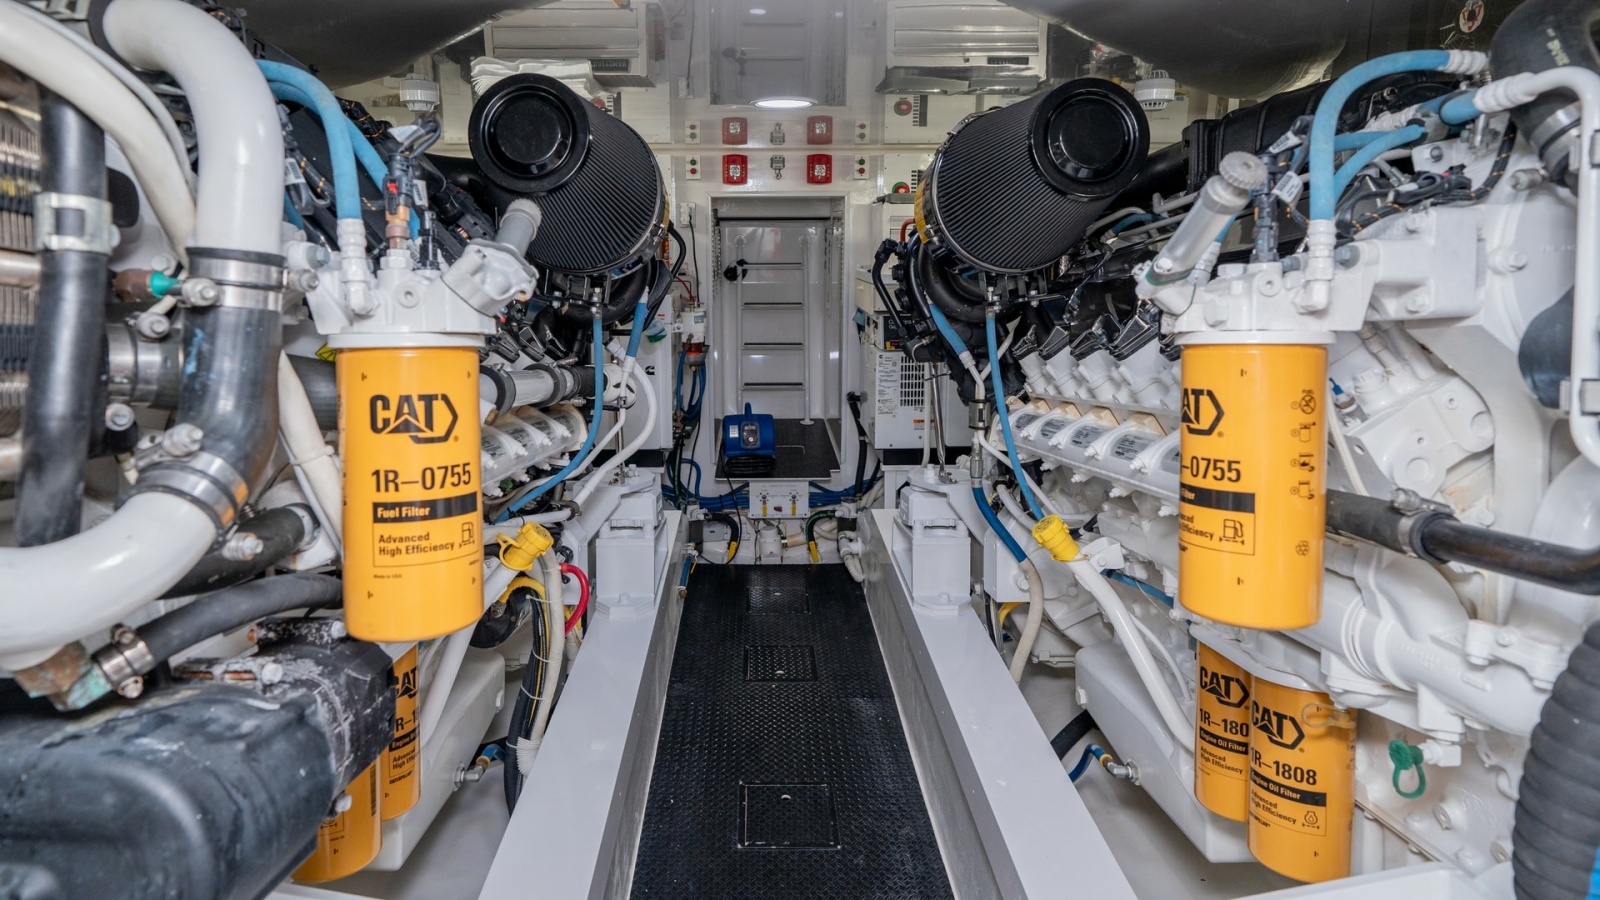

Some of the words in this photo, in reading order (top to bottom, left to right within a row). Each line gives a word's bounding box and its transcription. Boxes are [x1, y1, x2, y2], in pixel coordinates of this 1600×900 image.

[370, 394, 439, 435] CAT
[371, 462, 471, 493] 1R-0755
[1180, 455, 1242, 483] -0755
[377, 507, 399, 518] Fuel
[401, 505, 431, 518] Filter
[378, 532, 431, 545] Advanced
[378, 545, 403, 558] High
[405, 542, 456, 556] Efficiency
[1200, 666, 1236, 701] CAT
[1200, 708, 1250, 738] 1R-180
[1251, 700, 1288, 741] CAT
[1200, 732, 1218, 745] Engine
[1218, 737, 1229, 748] Oil
[1229, 740, 1247, 753] Filter
[1201, 746, 1226, 763] Advanced
[1212, 759, 1244, 775] Efficiency
[1252, 789, 1278, 810] Advanced
[1269, 784, 1280, 796] Oil
[1280, 788, 1302, 800] Filter
[1262, 804, 1298, 826] Efficiency
